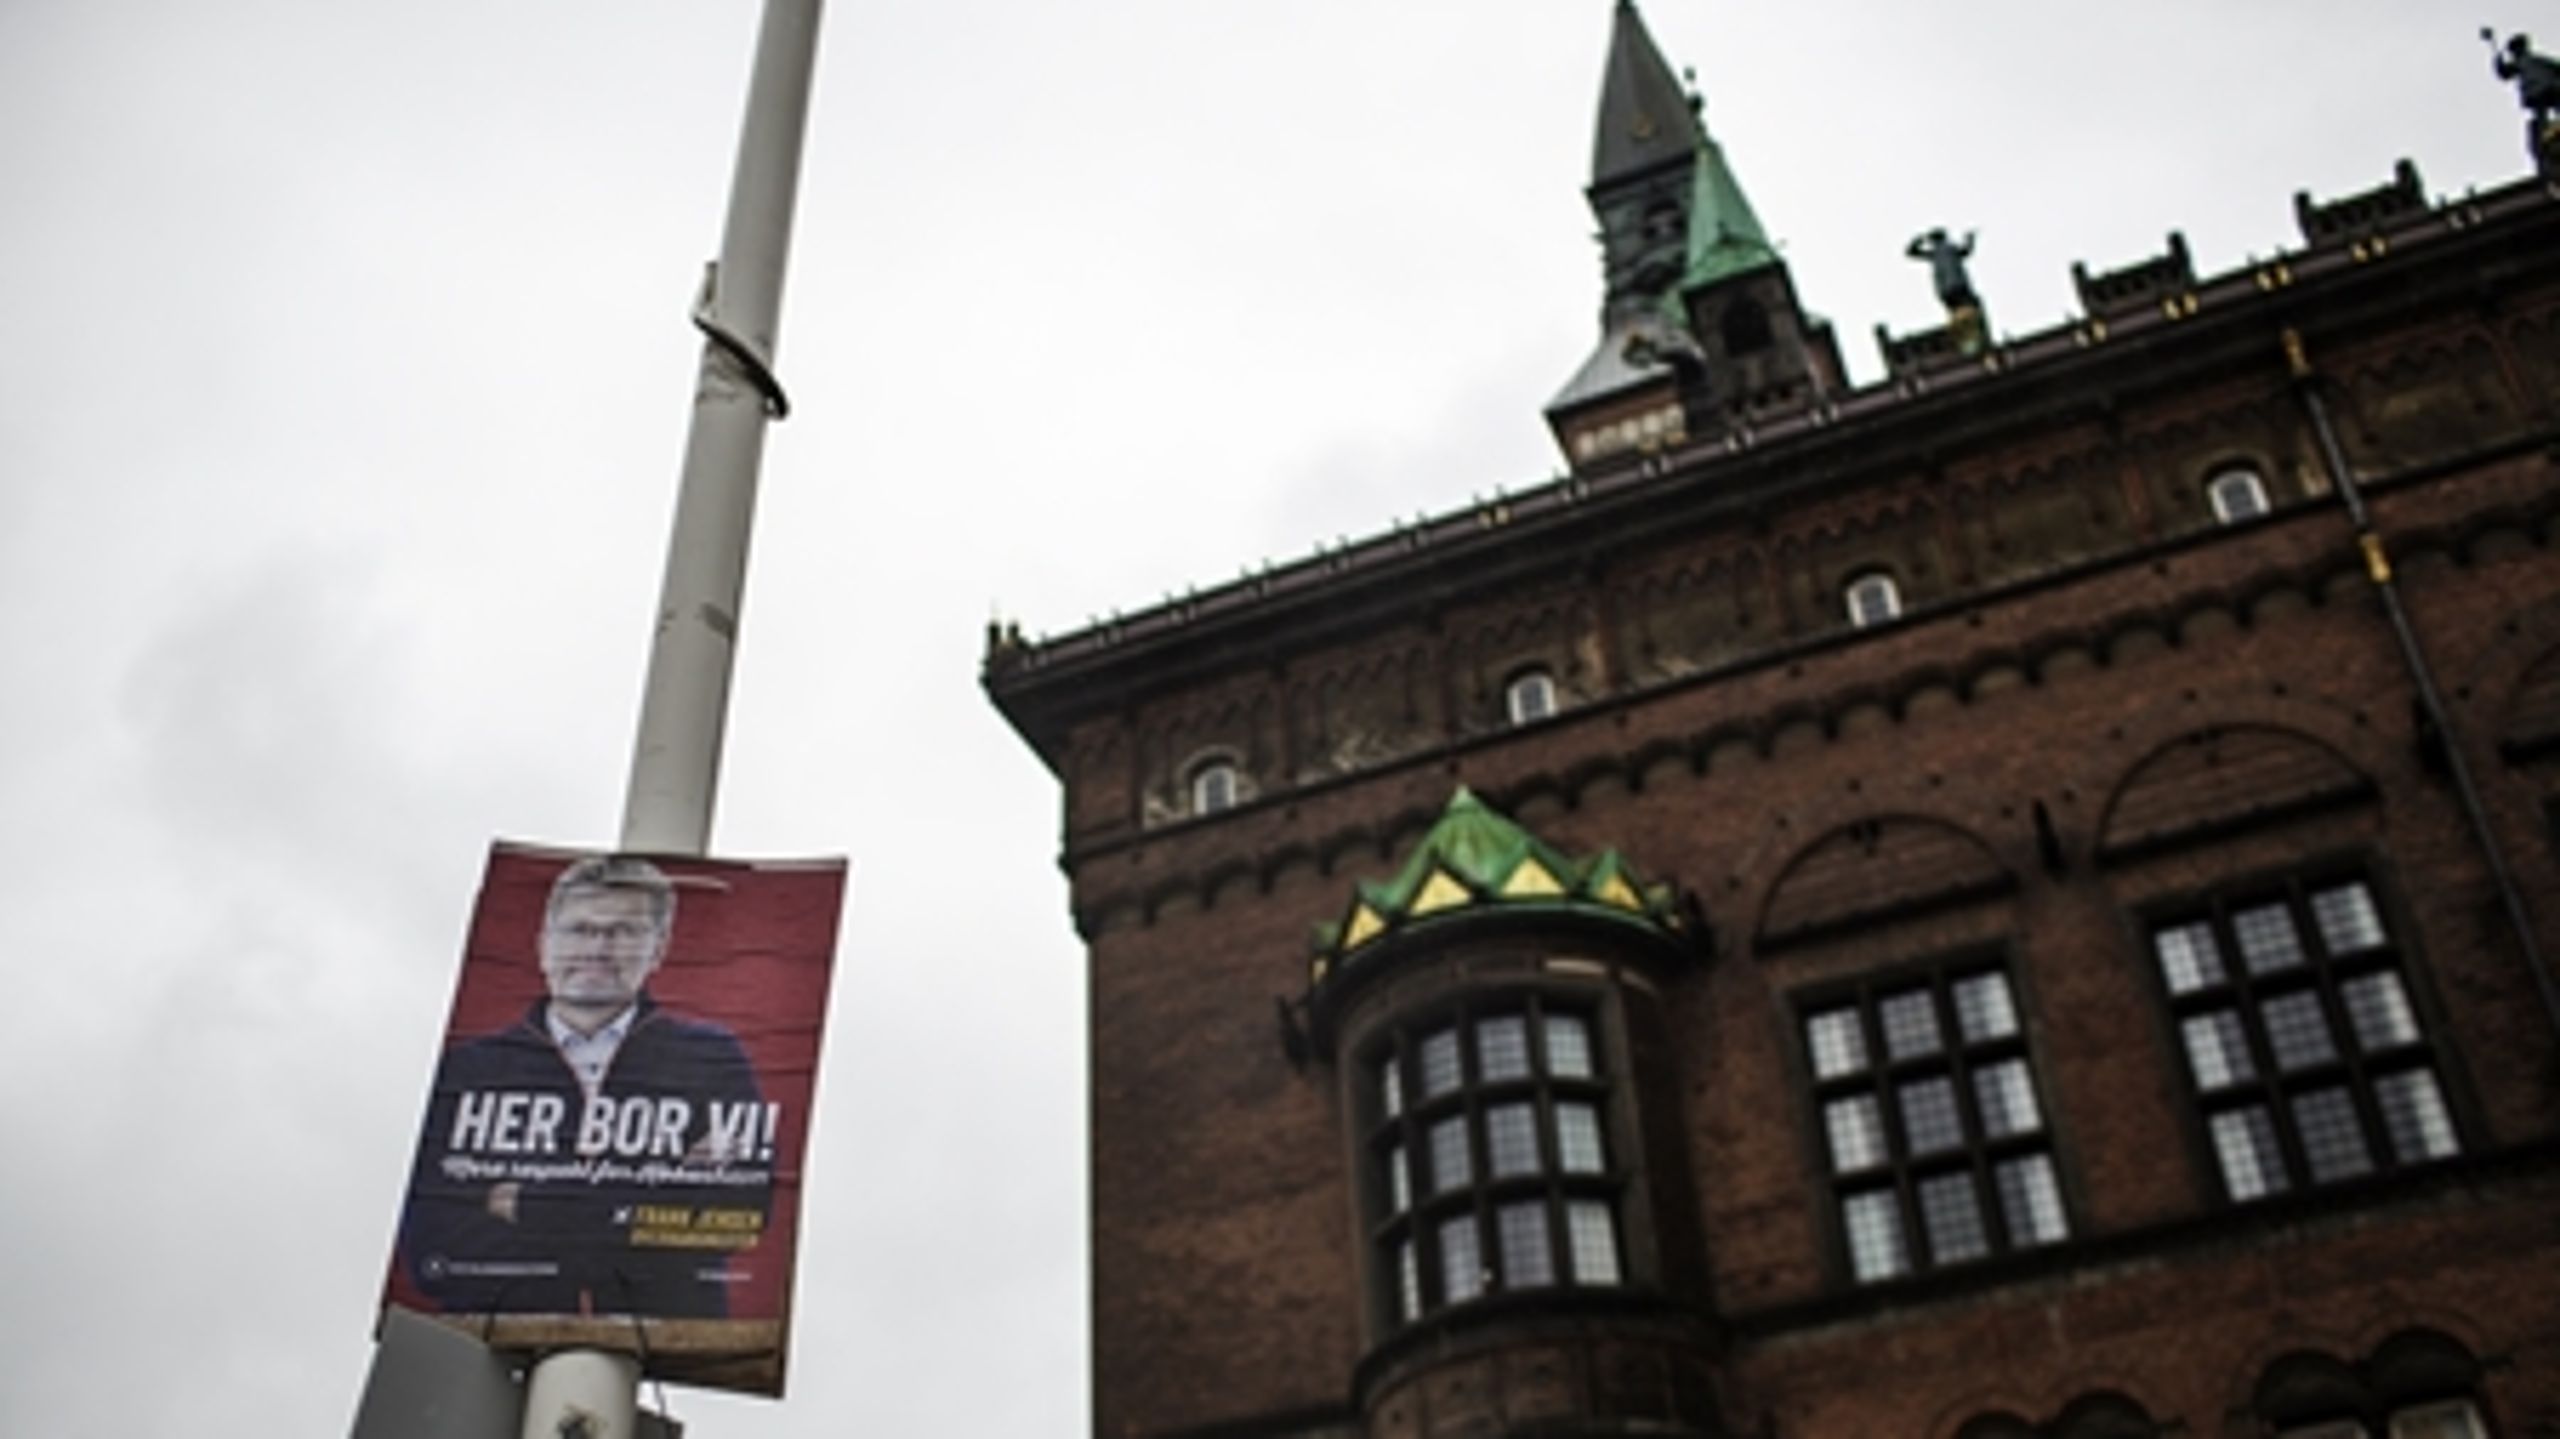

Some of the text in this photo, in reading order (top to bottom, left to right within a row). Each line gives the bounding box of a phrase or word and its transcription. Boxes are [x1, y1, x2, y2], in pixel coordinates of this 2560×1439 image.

[449, 1092, 781, 1161] HER BOR VI!
